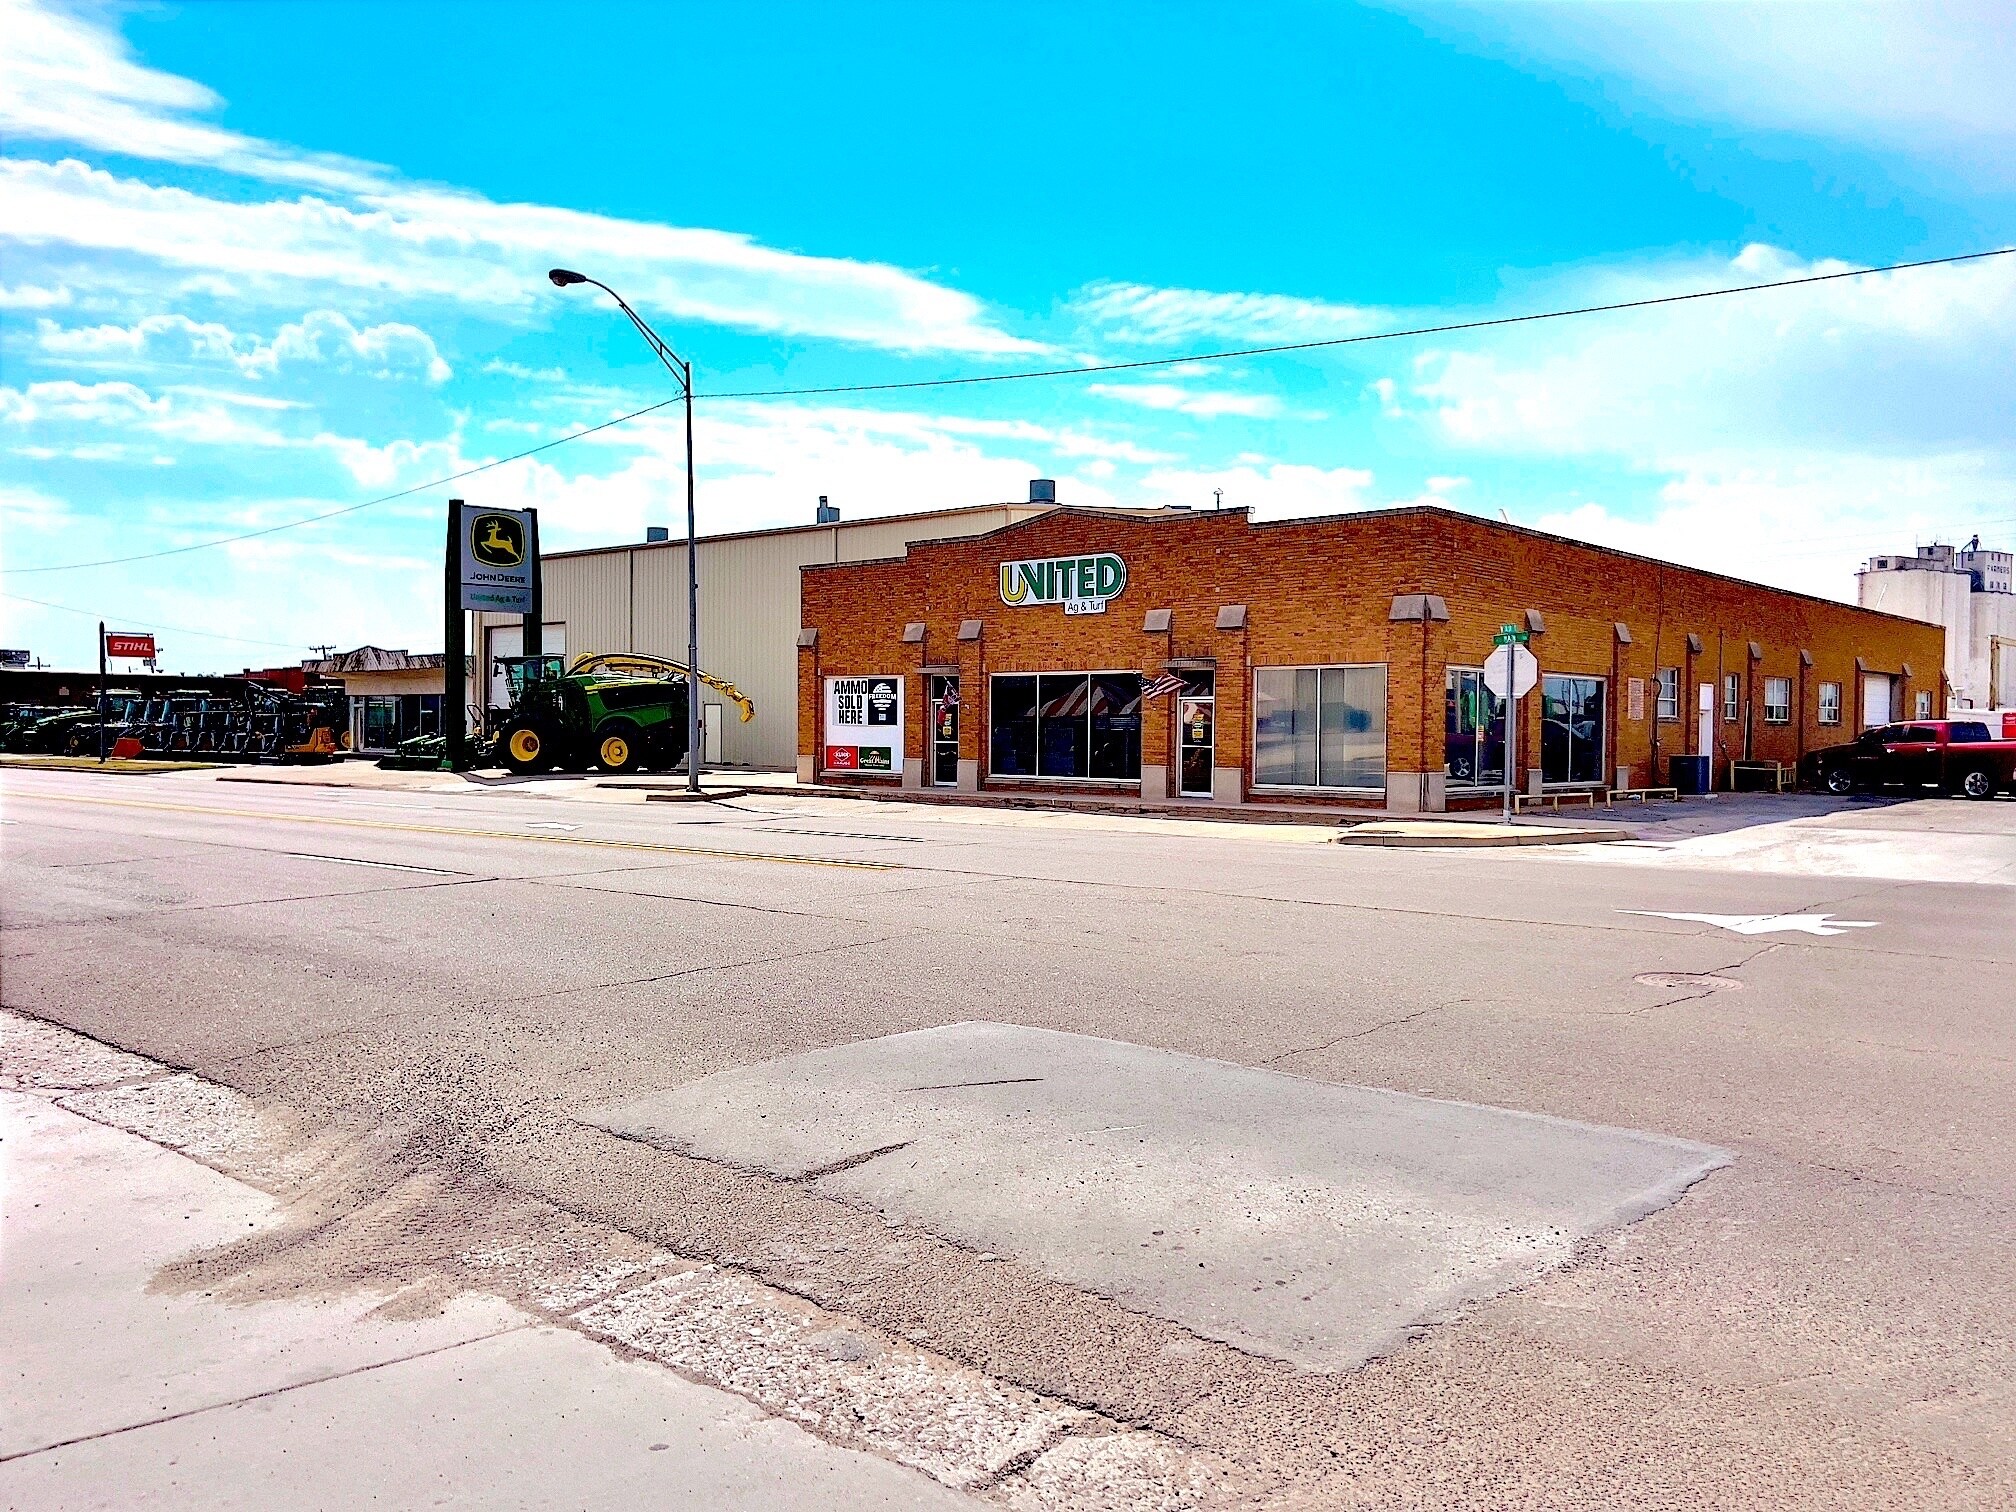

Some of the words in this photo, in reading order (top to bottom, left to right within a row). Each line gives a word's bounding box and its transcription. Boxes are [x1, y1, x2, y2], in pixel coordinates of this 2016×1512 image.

[470, 572, 497, 581] JOHN
[497, 574, 526, 583] DEERE
[1001, 556, 1125, 603] UNITED
[1067, 602, 1079, 613] Ag
[1080, 602, 1087, 611] &
[1089, 601, 1104, 610] Turf
[112, 641, 152, 652] STIHL
[833, 680, 867, 694] AMMO
[838, 694, 863, 709] SOLD
[838, 709, 863, 724] HERE
